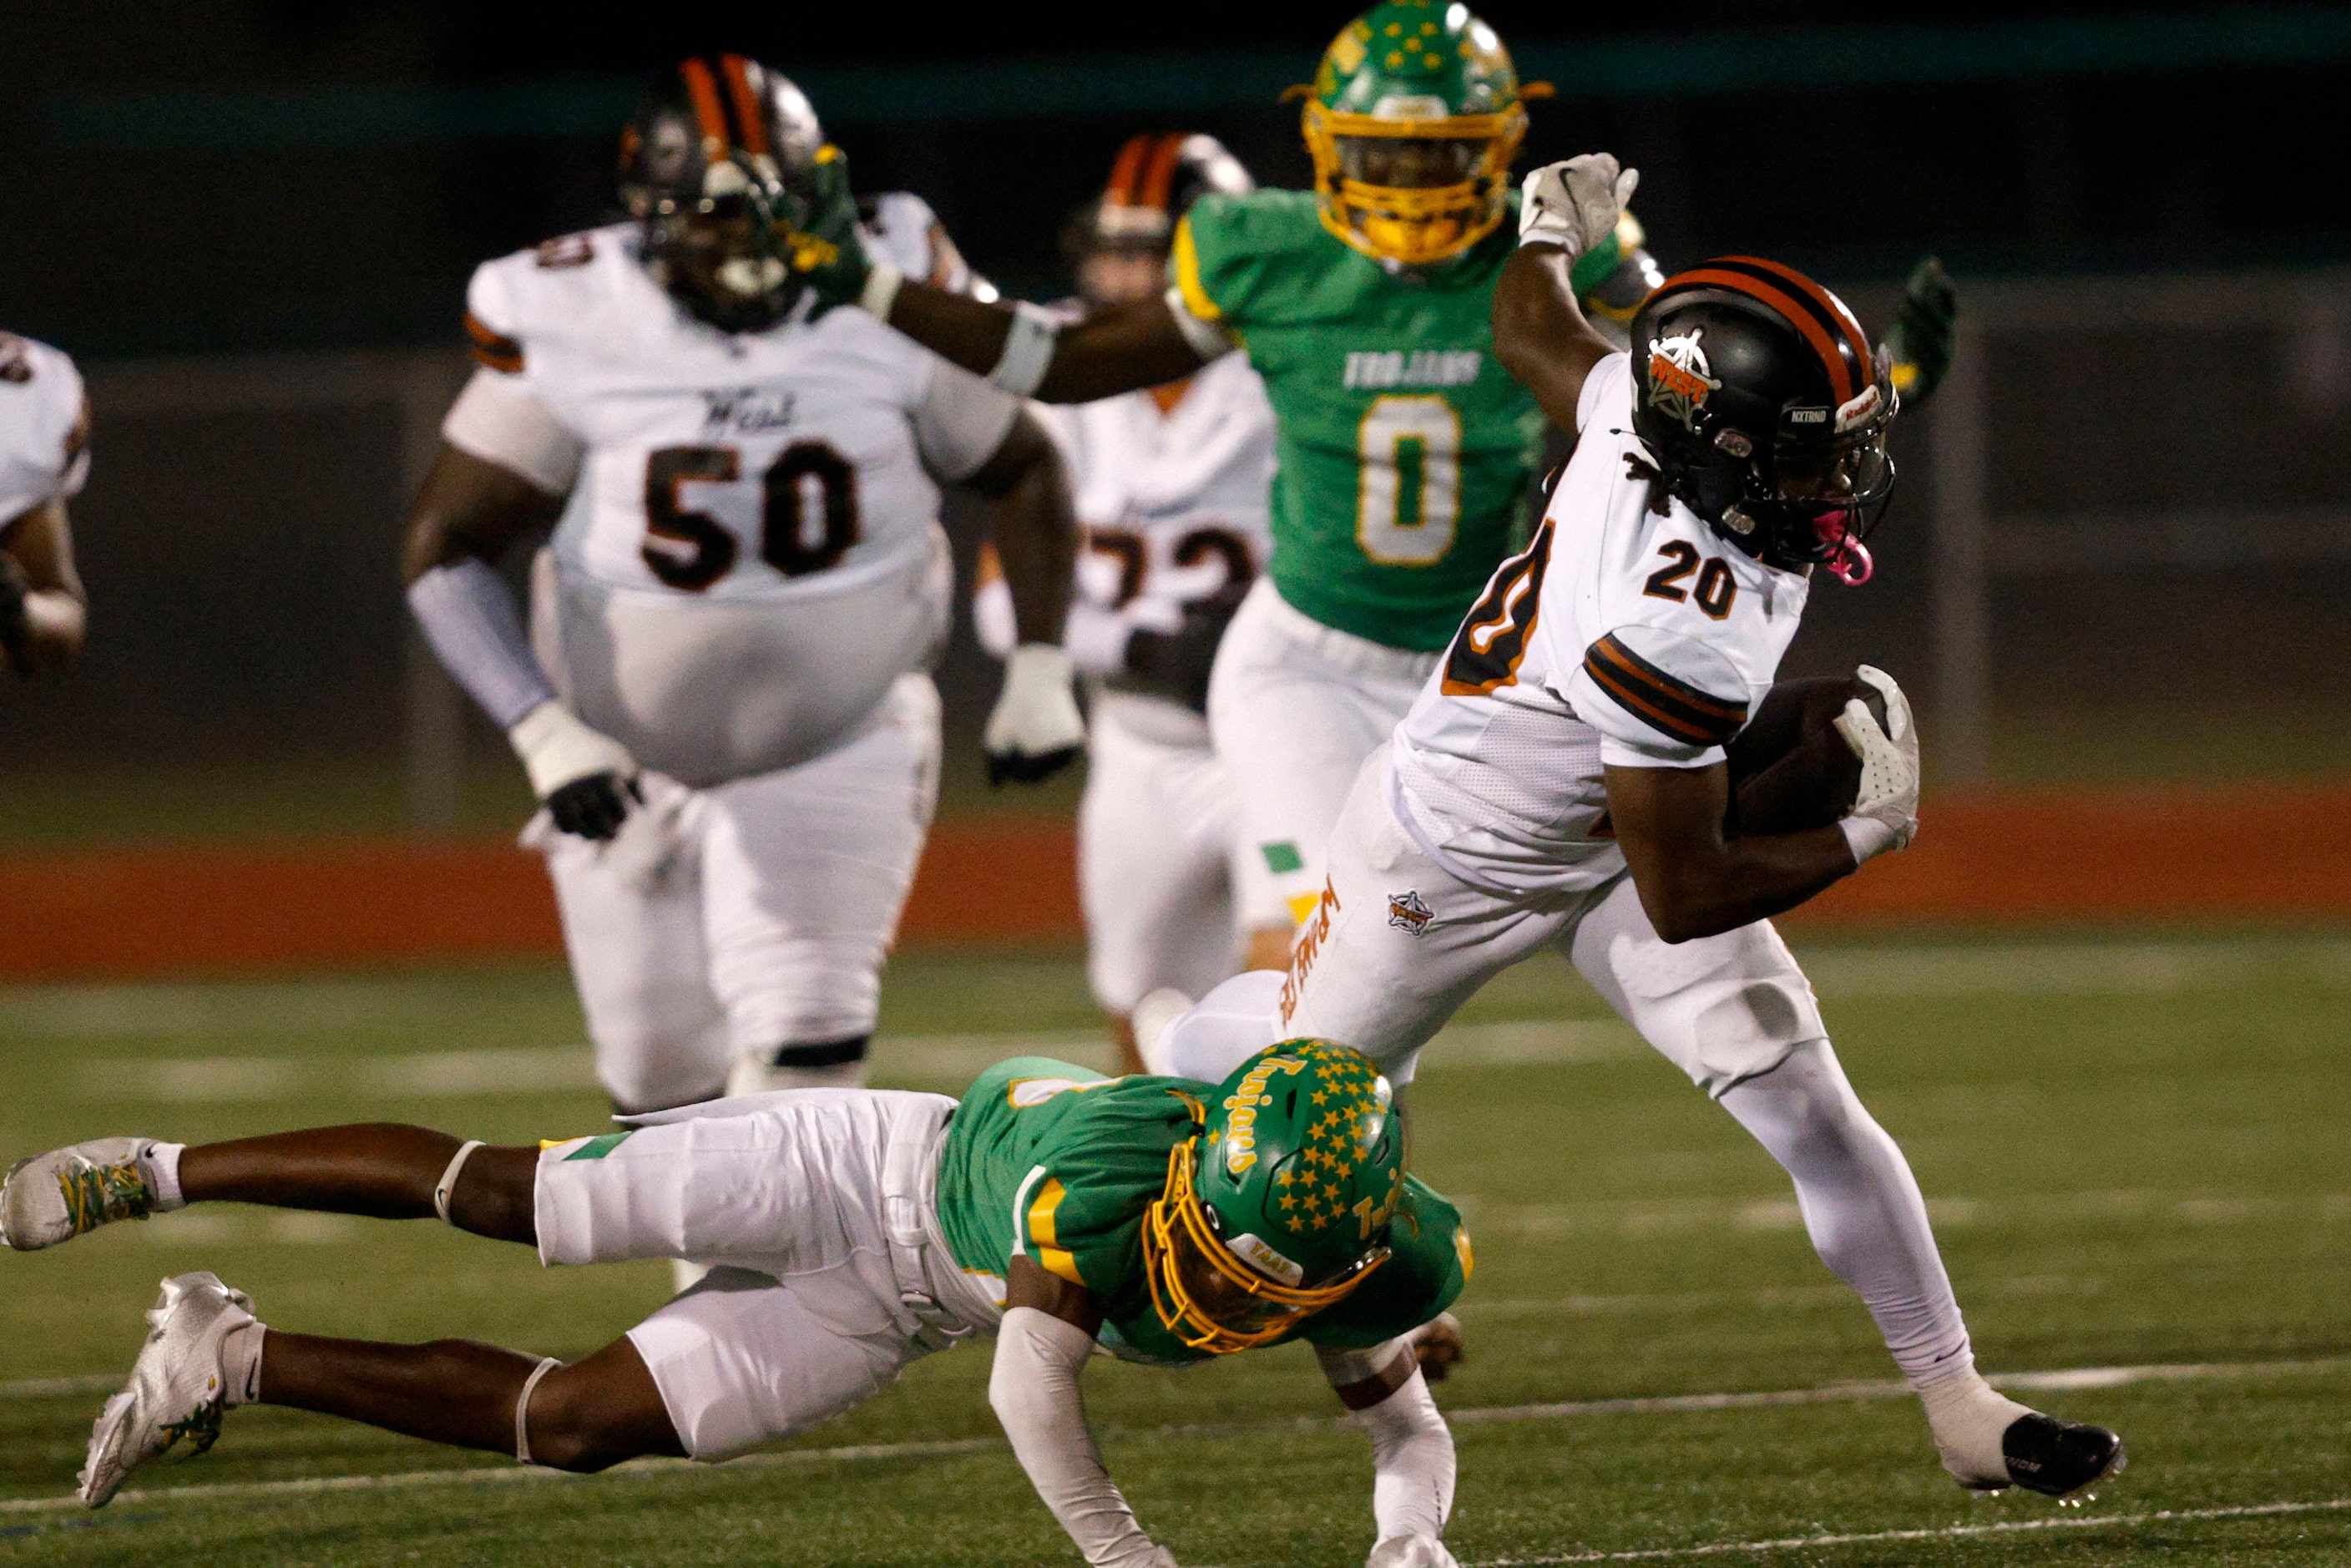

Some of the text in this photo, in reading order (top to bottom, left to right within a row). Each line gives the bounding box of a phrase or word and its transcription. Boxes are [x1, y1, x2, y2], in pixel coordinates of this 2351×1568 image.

[1342, 349, 1484, 390] TROJANS
[1791, 409, 1827, 423] NXTRND
[640, 437, 862, 594] 50
[1355, 392, 1463, 568] 0
[1642, 539, 1739, 621] 20
[1222, 1057, 1308, 1174] Trojans
